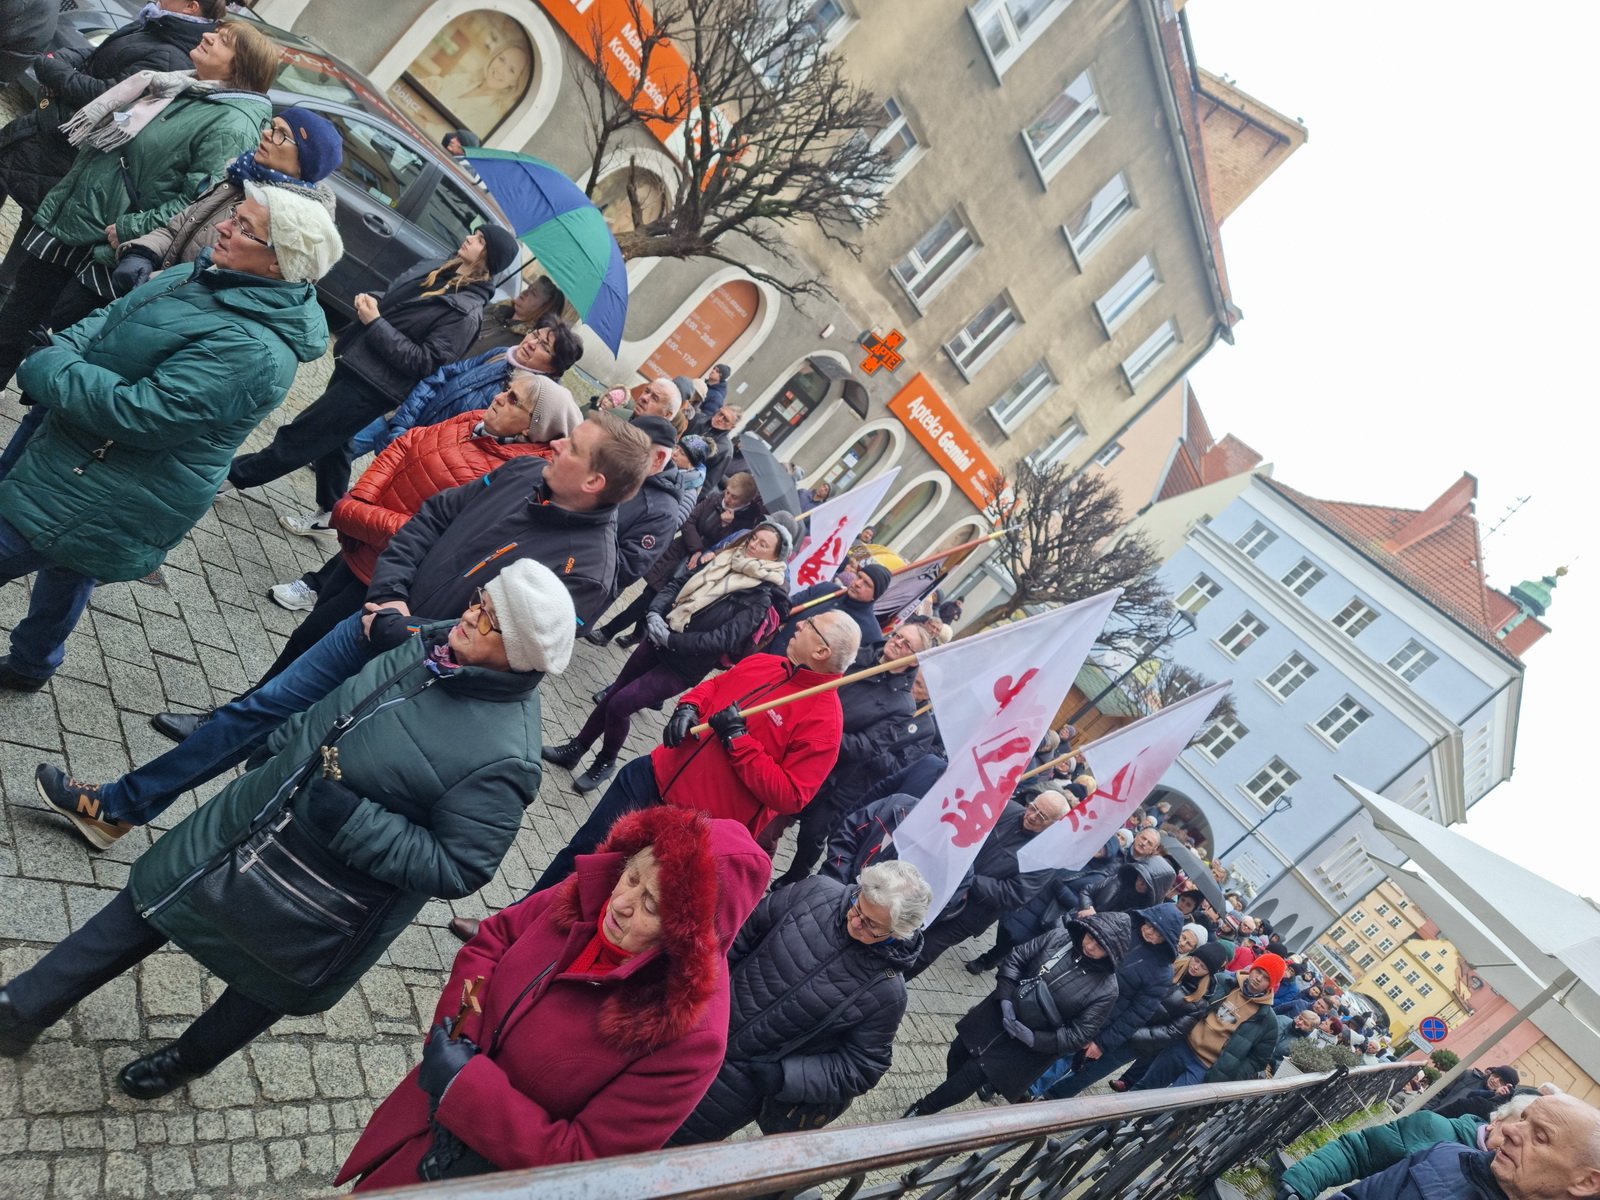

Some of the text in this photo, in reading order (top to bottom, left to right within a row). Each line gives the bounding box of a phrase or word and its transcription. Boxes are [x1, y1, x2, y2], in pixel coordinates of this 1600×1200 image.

[907, 395, 976, 473] Apteka Gemini
[76, 793, 99, 818] N
